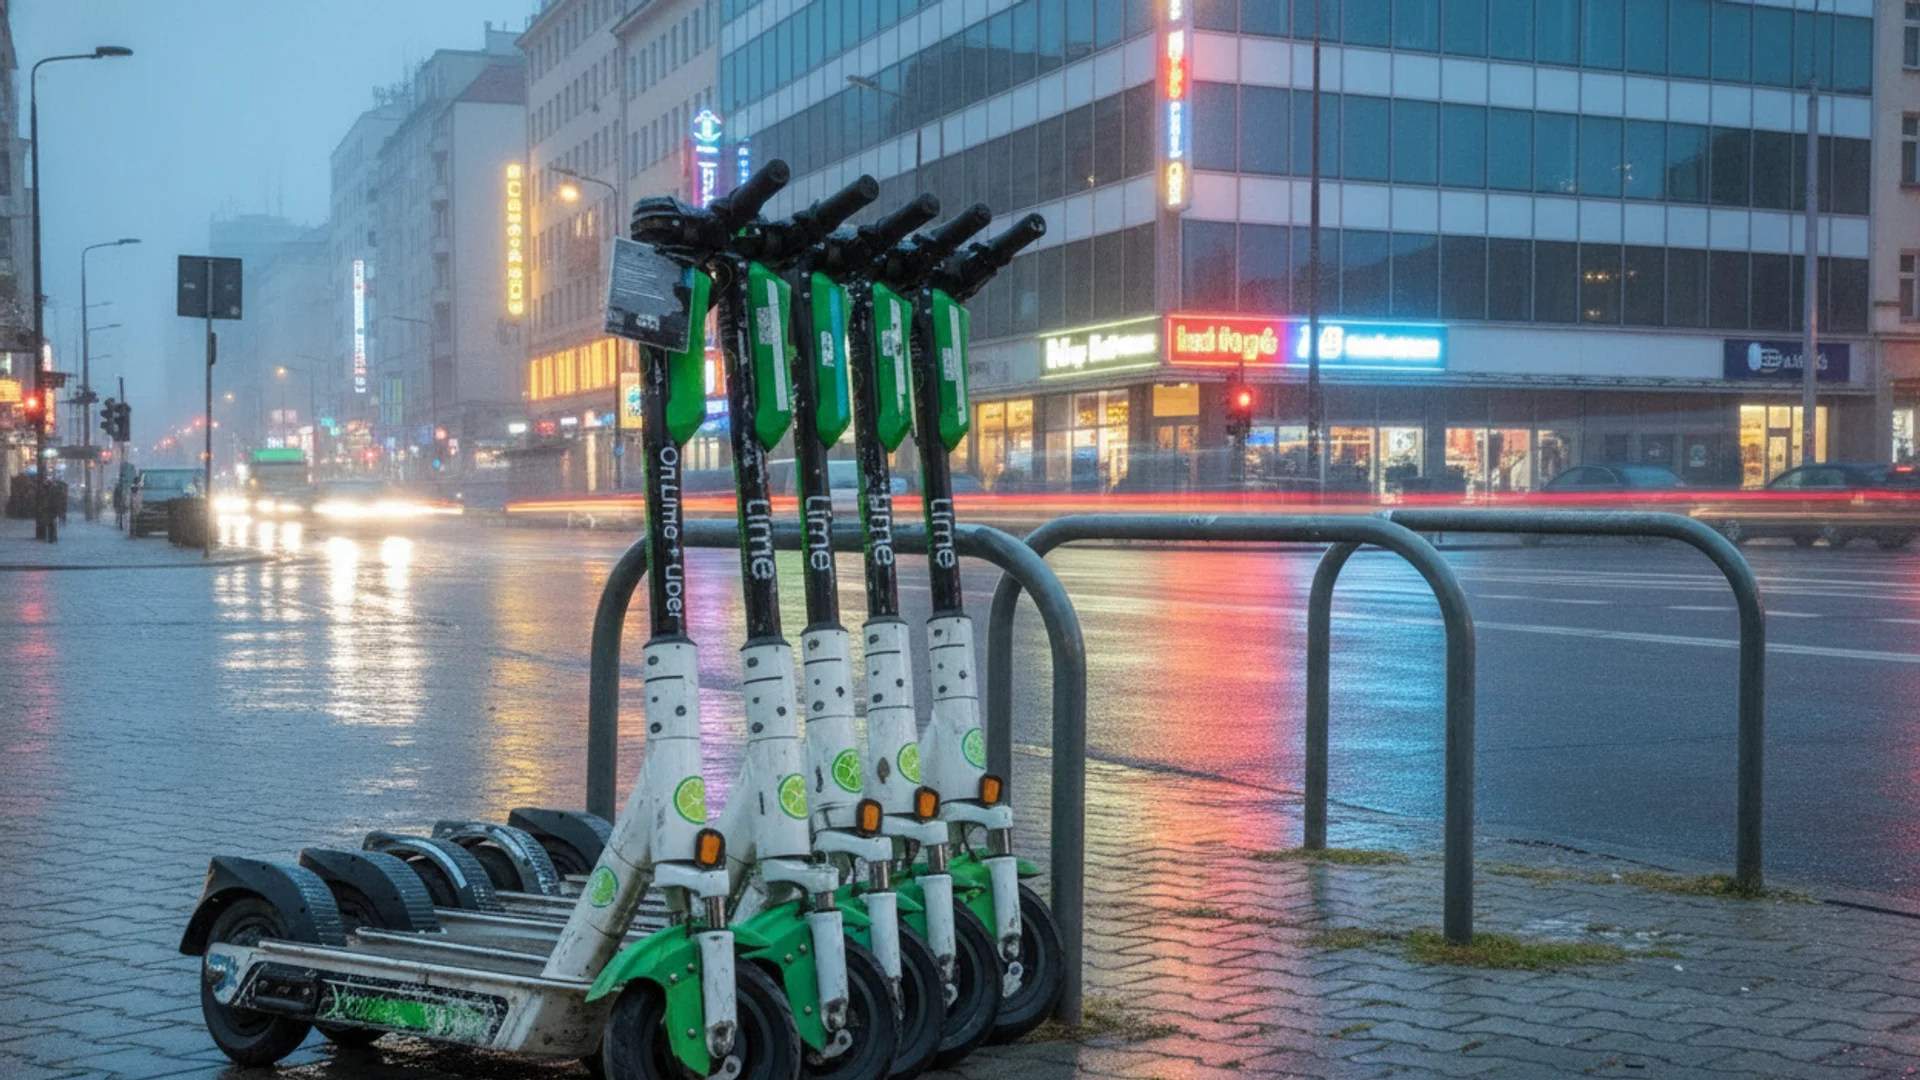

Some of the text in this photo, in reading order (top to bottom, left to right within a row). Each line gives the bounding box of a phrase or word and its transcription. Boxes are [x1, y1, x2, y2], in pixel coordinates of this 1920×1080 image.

[660, 446, 679, 480] On
[746, 499, 775, 580] Lime
[806, 495, 832, 571] Lime
[931, 498, 956, 569] Lime
